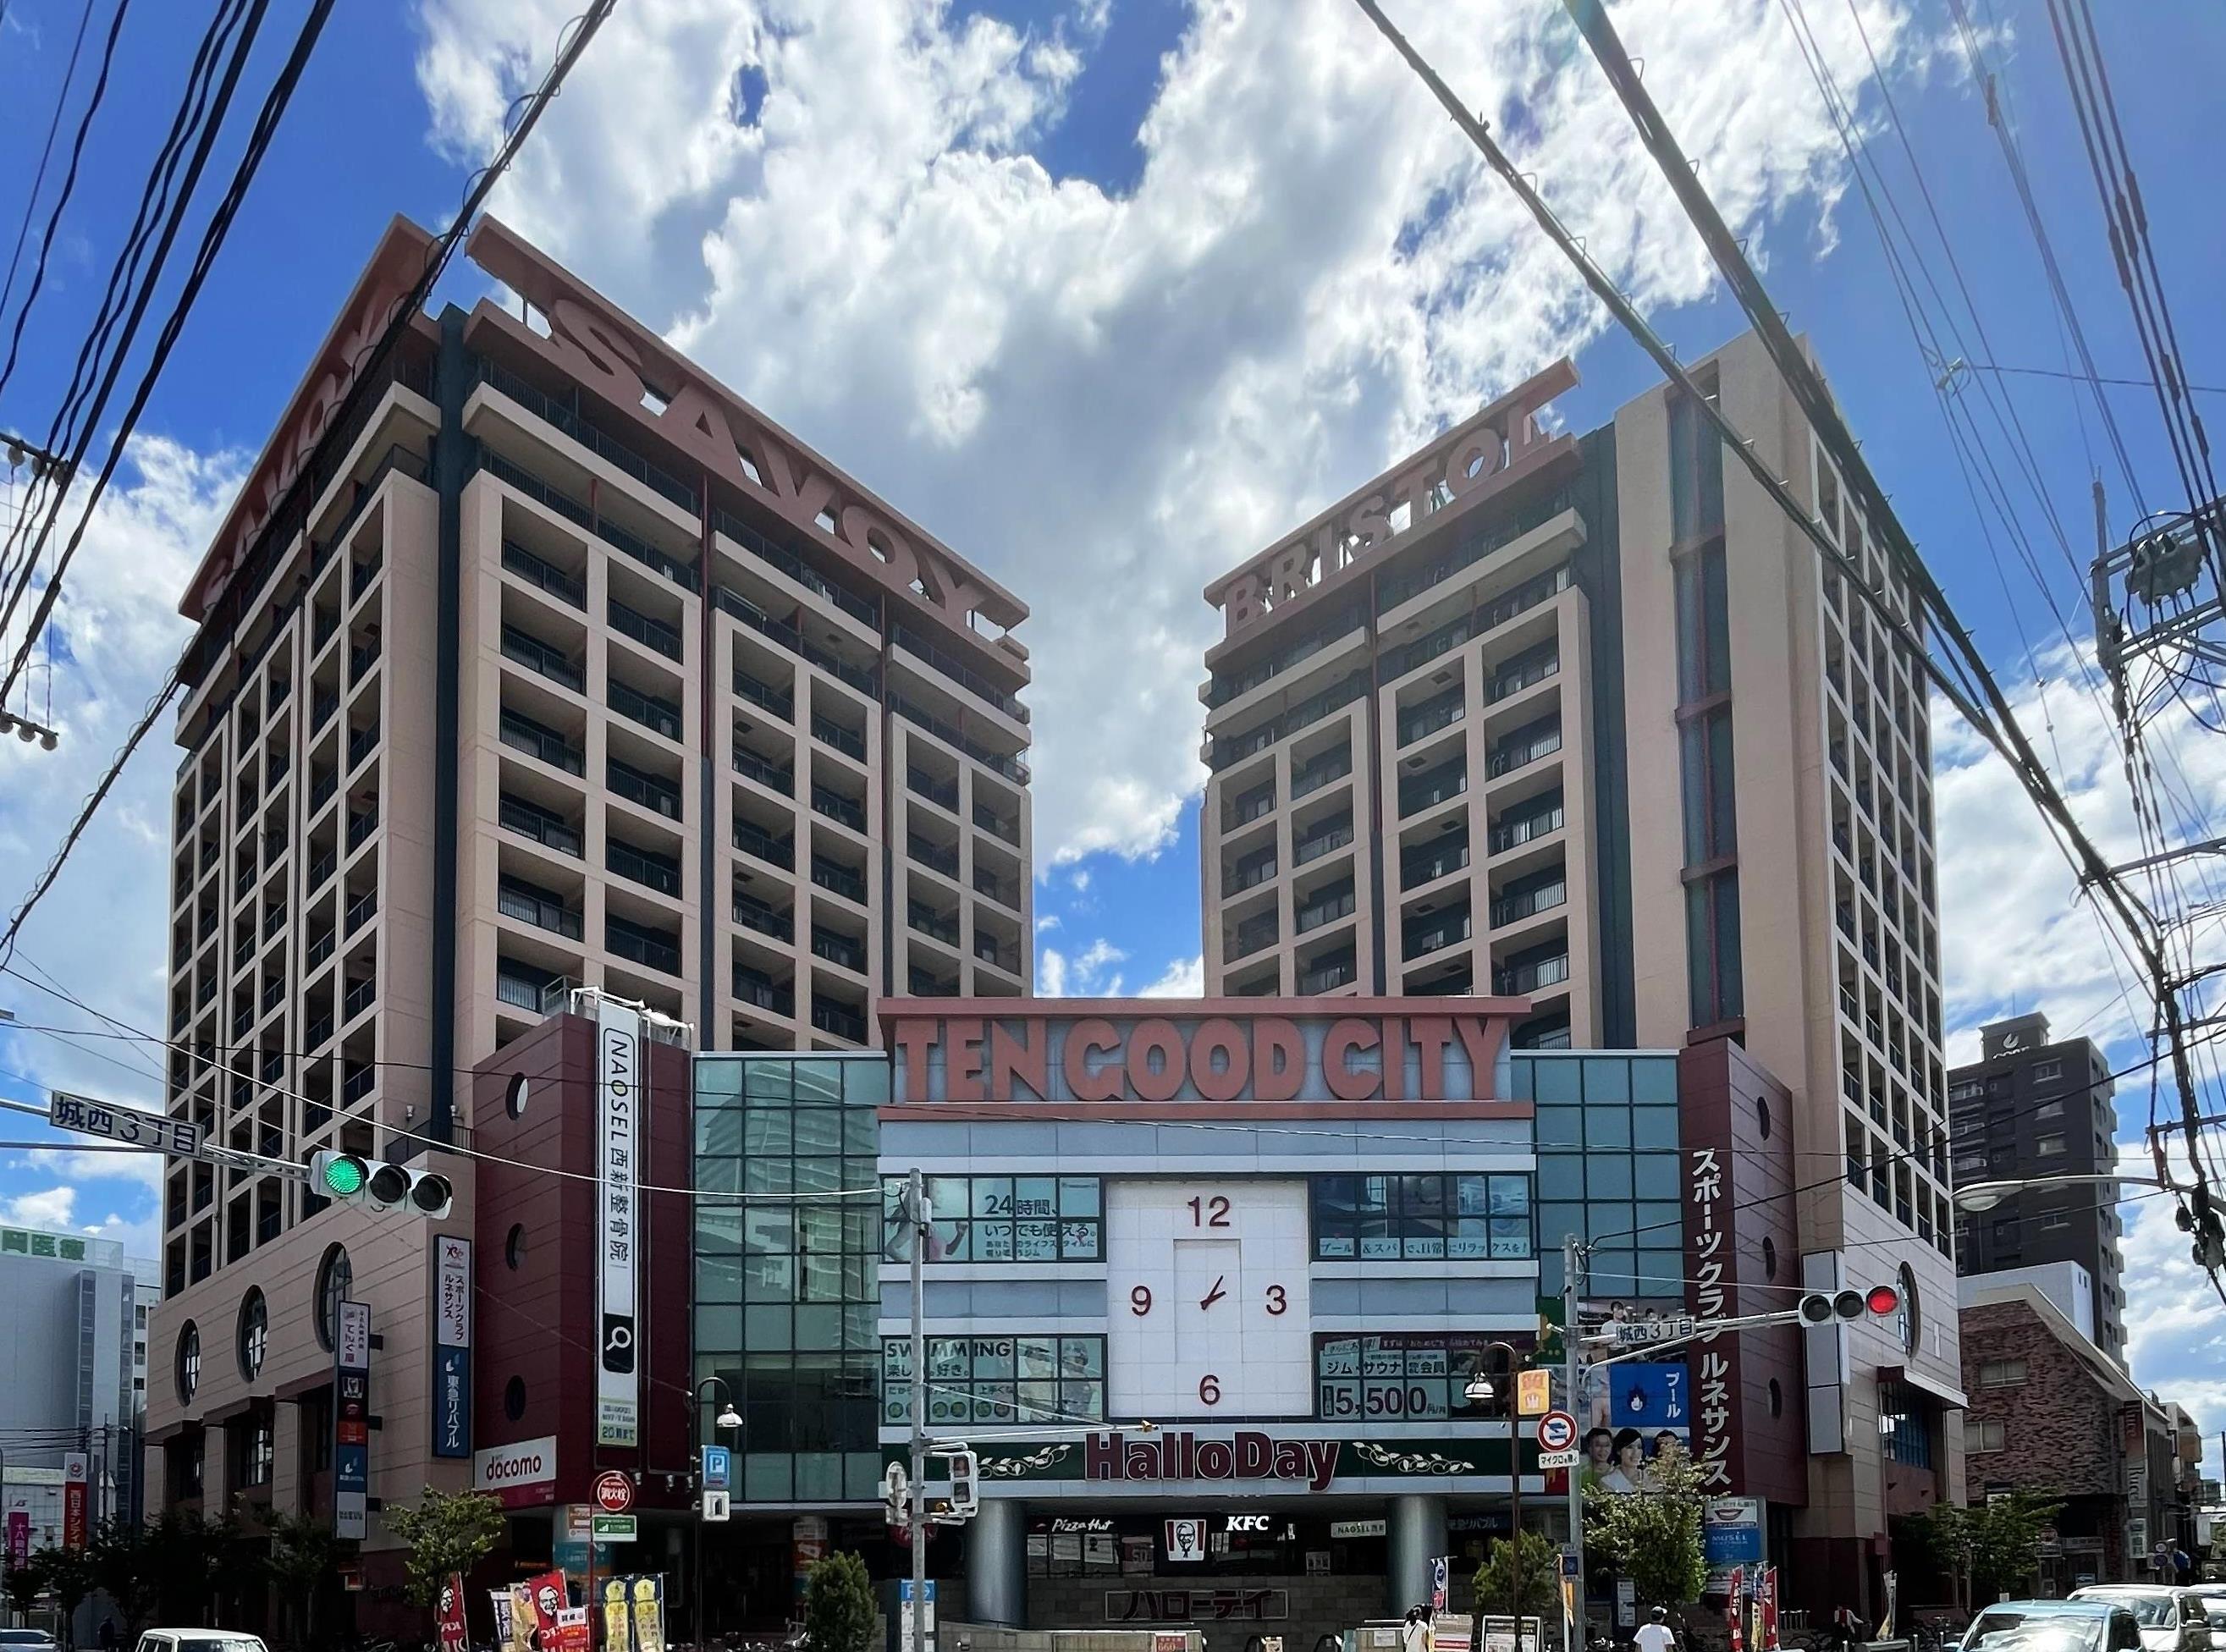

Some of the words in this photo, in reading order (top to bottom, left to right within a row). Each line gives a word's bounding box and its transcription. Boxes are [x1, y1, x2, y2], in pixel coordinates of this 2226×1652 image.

[548, 298, 980, 628] SAVOY
[1225, 399, 1552, 635] BRISTOL
[895, 1017, 1047, 1101] TEN
[1064, 1017, 1307, 1101] GOOD
[1323, 1017, 1509, 1101] CITY
[610, 1038, 629, 1141] NAOSEL
[610, 1147, 630, 1261] 西新整骨院
[1187, 1196, 1231, 1227] 12
[444, 1274, 455, 1319] ルネサンス
[455, 1275, 465, 1341] スポーツクラブ
[1131, 1286, 1152, 1316] 9
[1266, 1285, 1287, 1315] 3
[446, 1374, 460, 1449] 東急リバブル
[1199, 1374, 1220, 1406] 6
[1666, 1371, 1682, 1418] プール
[1700, 1352, 1733, 1486] ルネサンス
[487, 1455, 542, 1481] docomo
[1086, 1431, 1341, 1492] HalloDay
[600, 1486, 627, 1501] 消火栓
[1051, 1518, 1087, 1532] Pizza
[1088, 1517, 1115, 1531] Hut
[1226, 1515, 1270, 1531] KFC
[1122, 1590, 1272, 1620] ハローデイ
